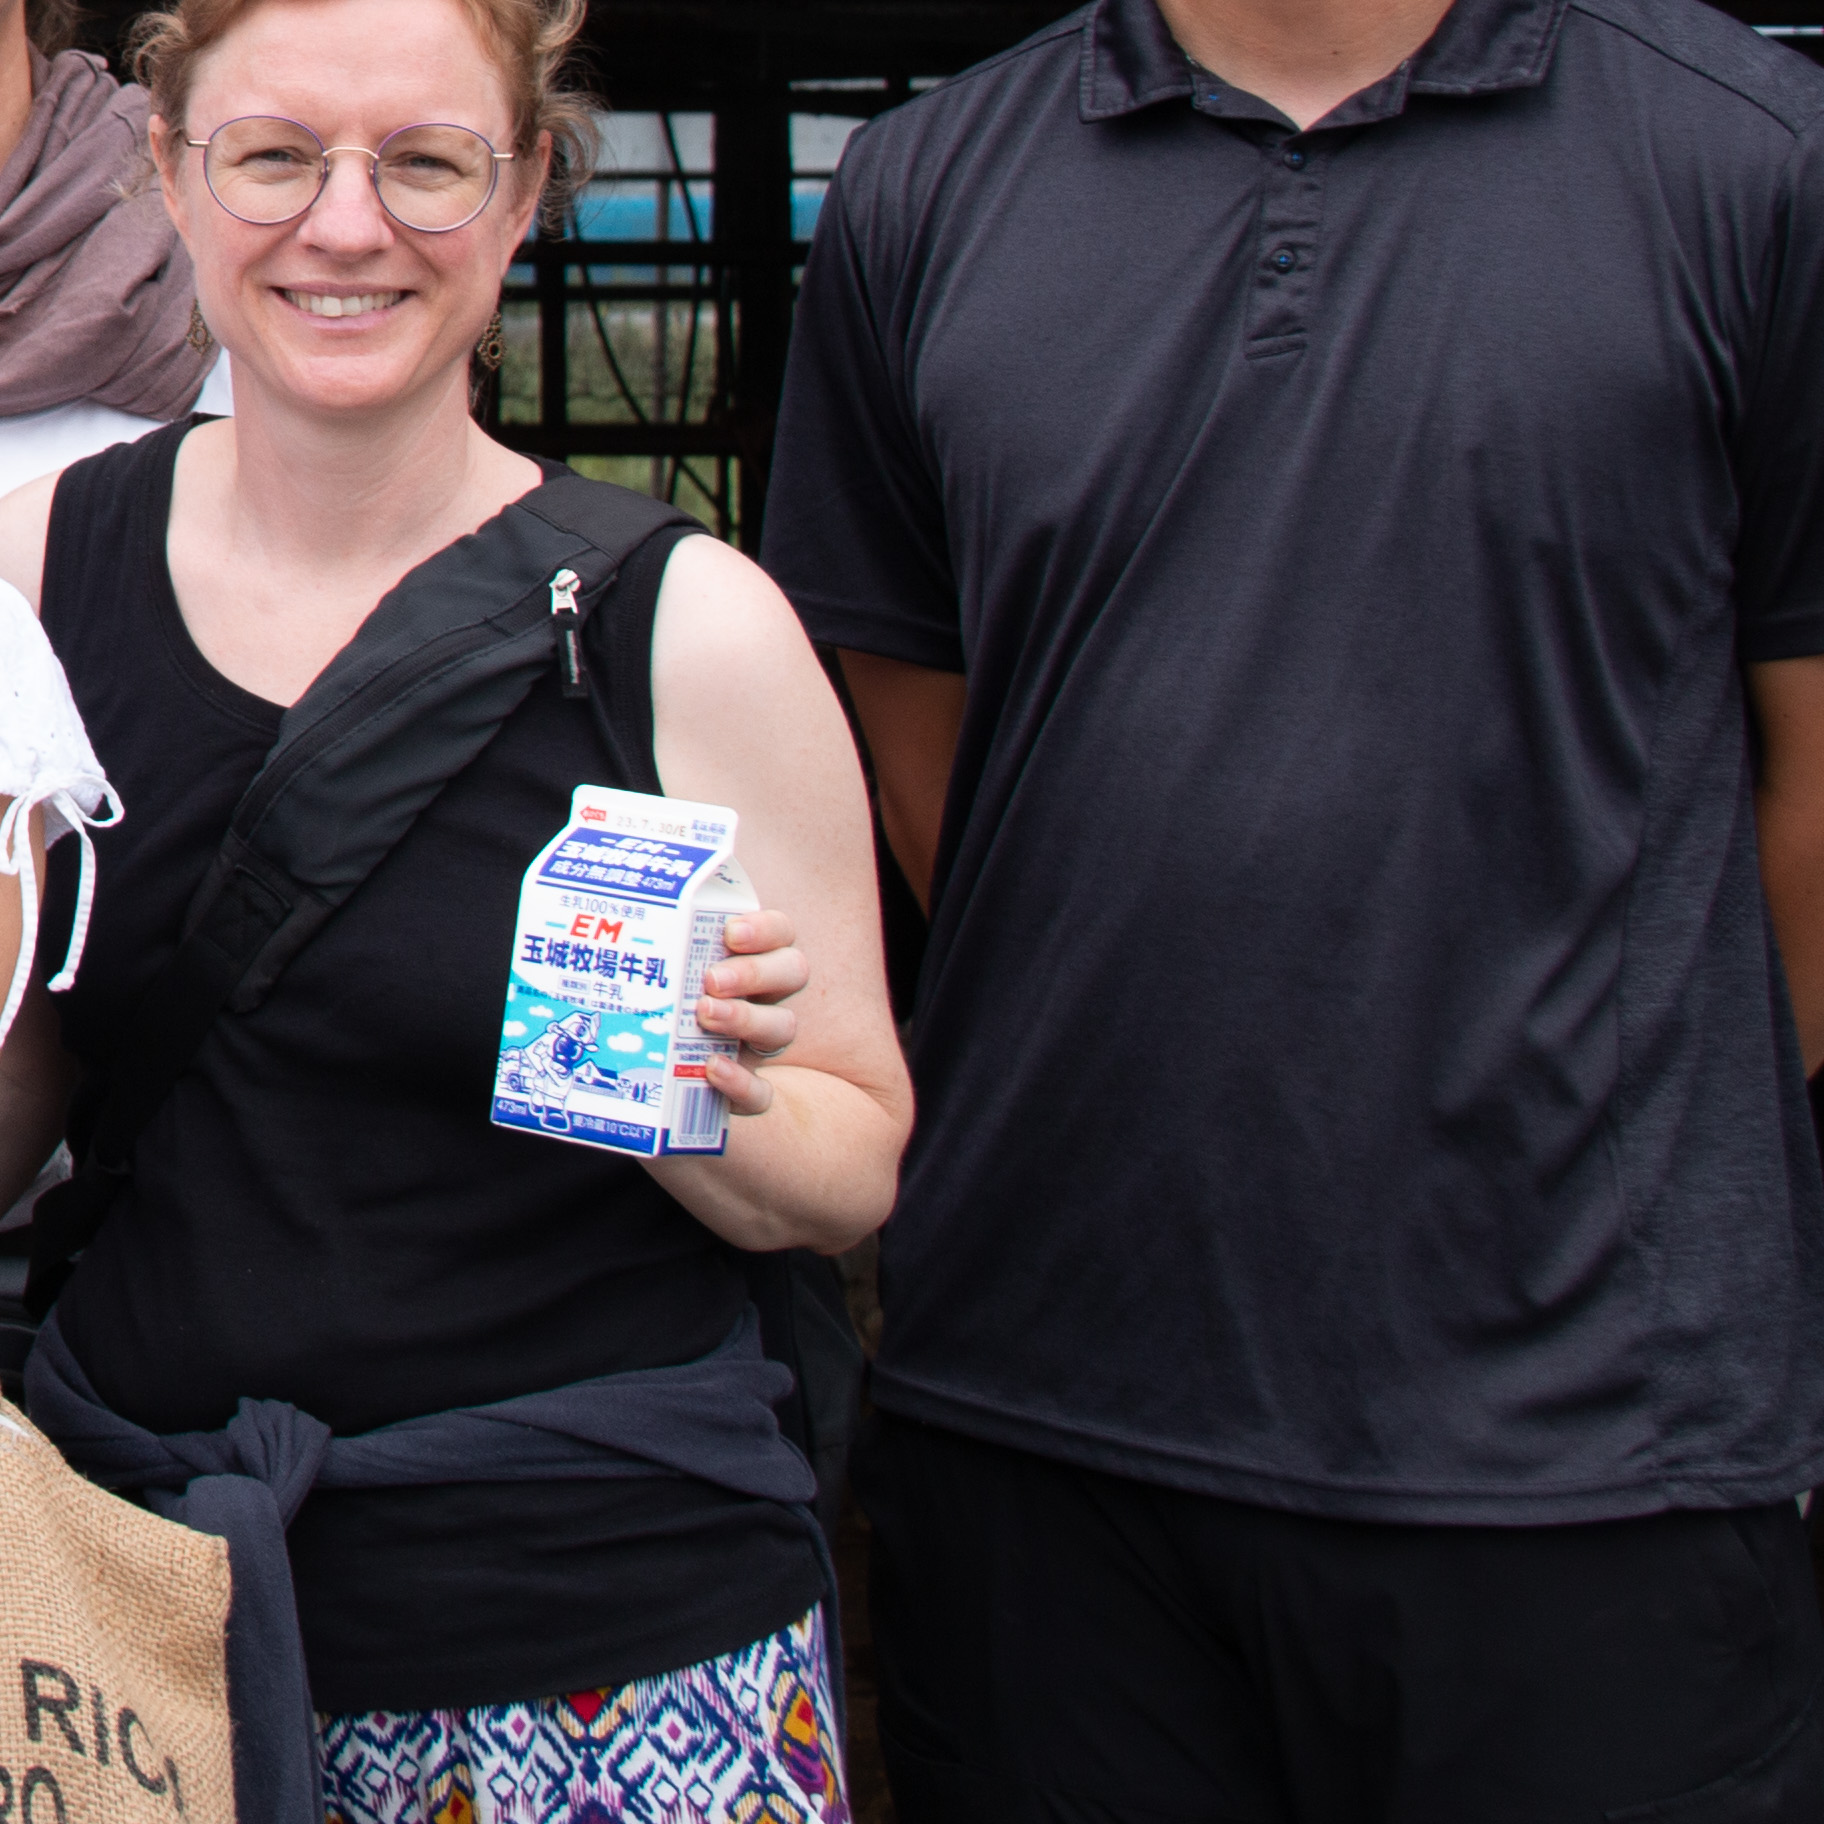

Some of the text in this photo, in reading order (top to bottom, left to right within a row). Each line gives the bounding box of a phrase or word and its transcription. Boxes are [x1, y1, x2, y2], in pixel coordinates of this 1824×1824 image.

[549, 860, 644, 887] 成分無調整
[555, 840, 695, 878] 玉城牧場牛乳
[570, 913, 624, 943] EM
[521, 933, 668, 989] 玉城牧場牛乳
[593, 981, 624, 1001] 牛乳
